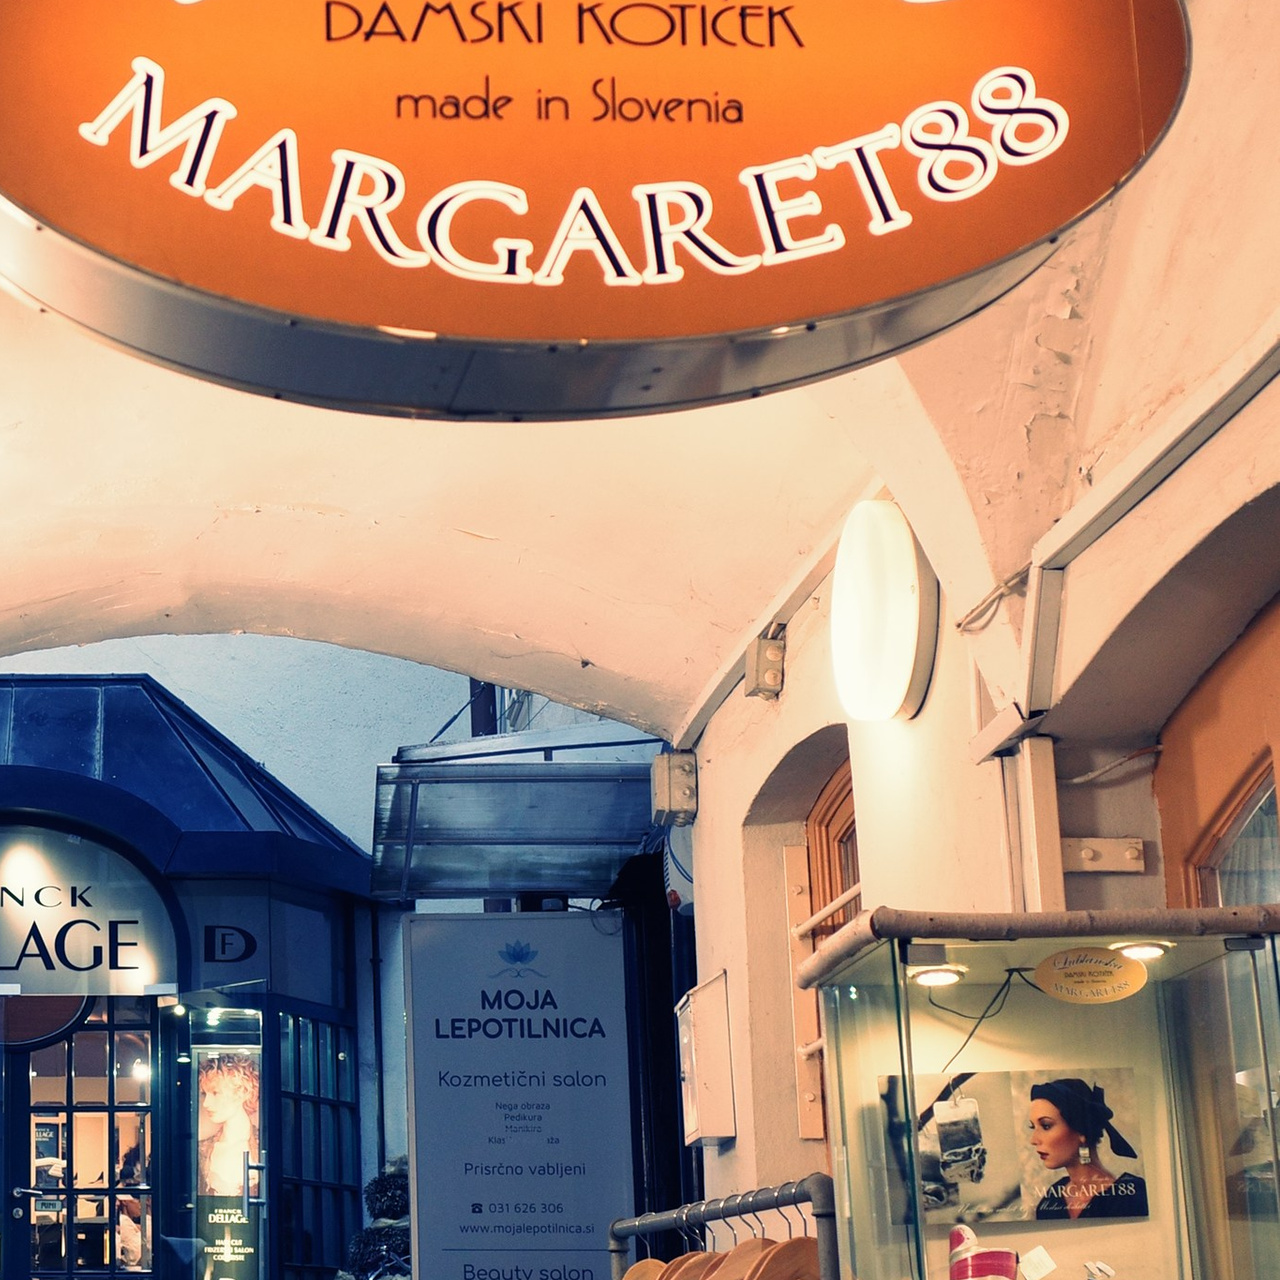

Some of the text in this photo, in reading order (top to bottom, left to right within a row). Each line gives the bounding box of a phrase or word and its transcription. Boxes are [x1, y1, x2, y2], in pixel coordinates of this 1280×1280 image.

[395, 76, 745, 125] made in Slovenia
[79, 57, 1070, 287] MARGARET88
[480, 989, 558, 1011] MOJA
[435, 1017, 606, 1039] LEPOTILNICA
[437, 1070, 607, 1088] Kozmetični salon
[495, 1101, 551, 1112] Nega obraza
[504, 1113, 543, 1122] Pedikura
[463, 1162, 586, 1178] Prisrčno vabljeni
[1034, 1182, 1136, 1199] MARGARET88
[488, 1202, 564, 1214] 031 626 306
[459, 1223, 595, 1235] www.mojalepotilnica.si
